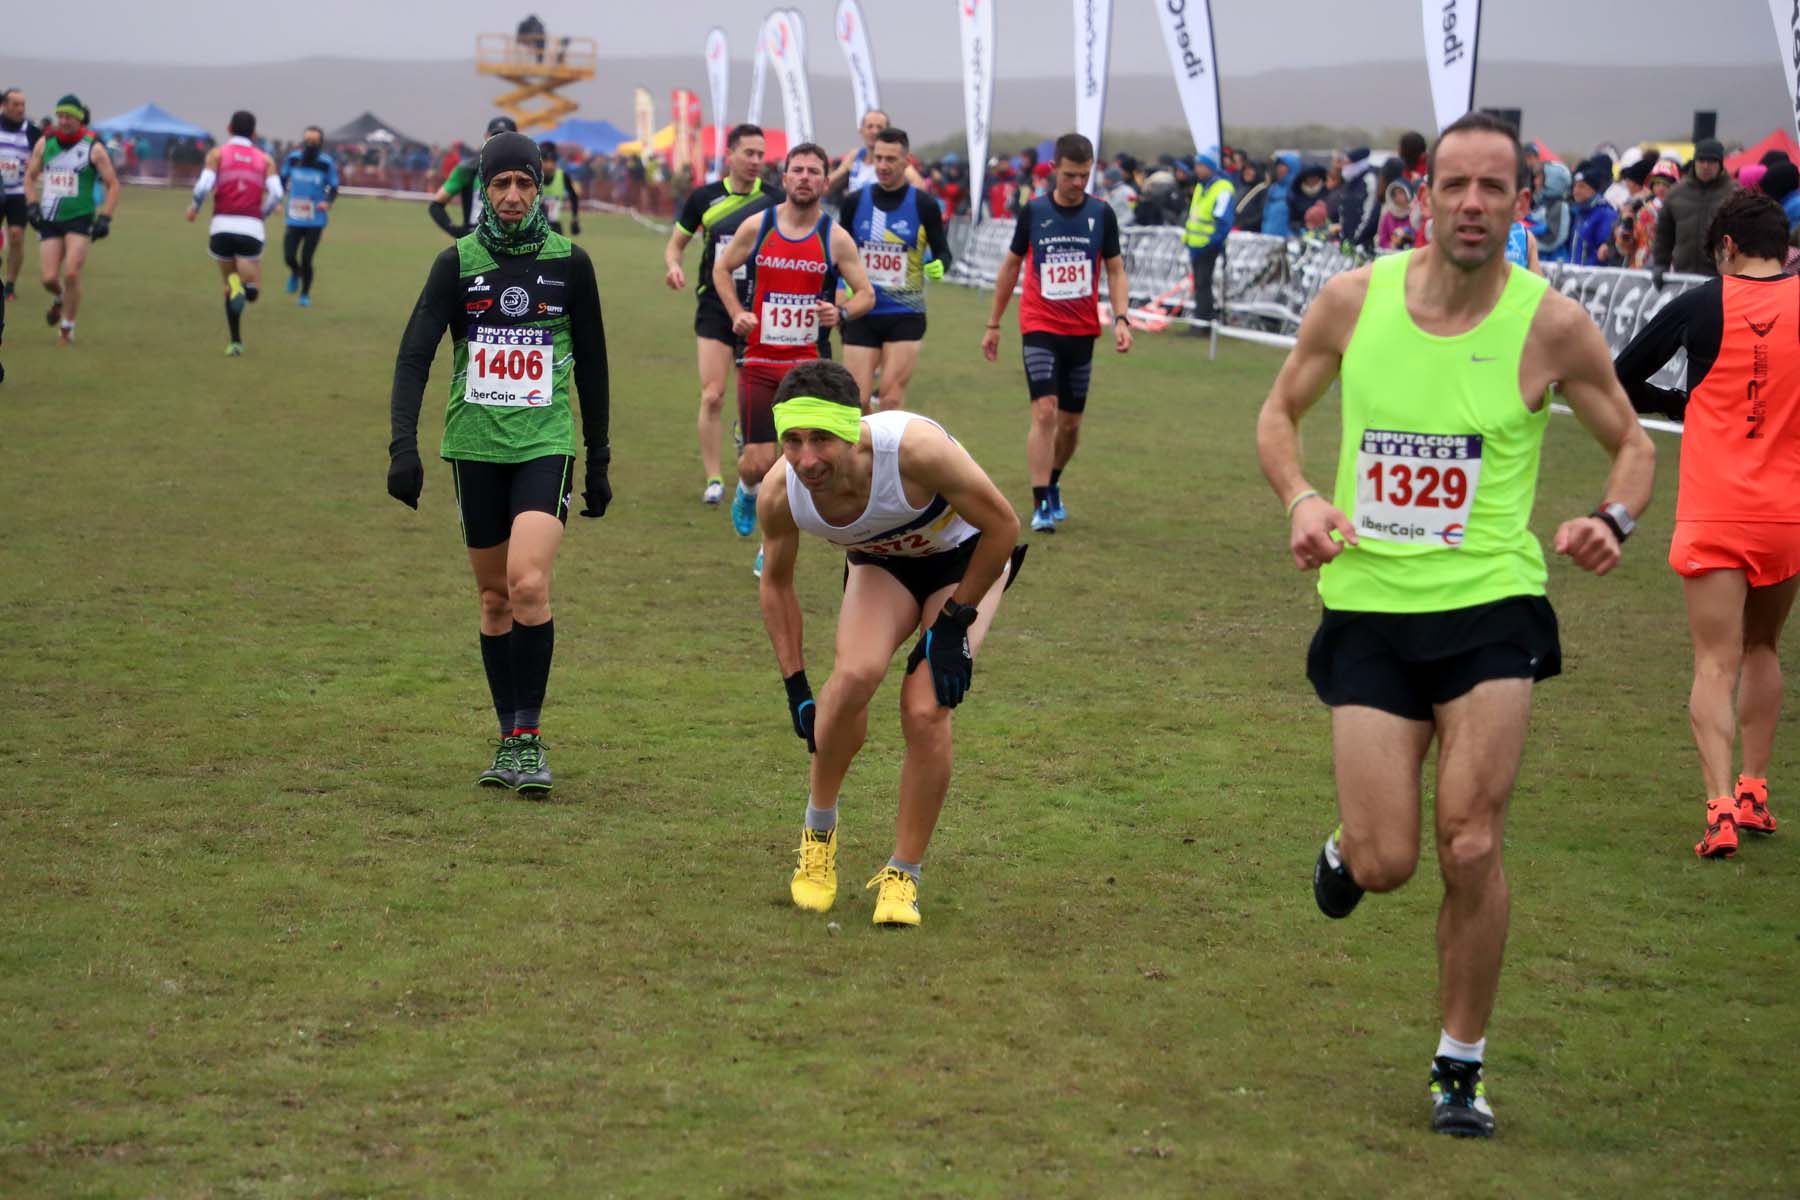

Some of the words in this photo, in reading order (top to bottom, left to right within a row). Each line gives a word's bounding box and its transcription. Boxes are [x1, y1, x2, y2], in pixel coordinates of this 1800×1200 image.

[755, 254, 828, 274] CAMARGO
[864, 253, 902, 272] 1306
[1048, 264, 1086, 284] 1281
[770, 307, 816, 328] 1315
[477, 326, 543, 337] DIPUTACIÓN
[477, 334, 543, 345] BURGOS
[474, 348, 544, 381] 1406
[470, 388, 516, 402] iberCaja
[1364, 431, 1468, 447] DIPUTACIÓN
[1364, 442, 1468, 459] BURGOS
[1367, 461, 1467, 509] 1329
[1361, 515, 1425, 539] iberCaja
